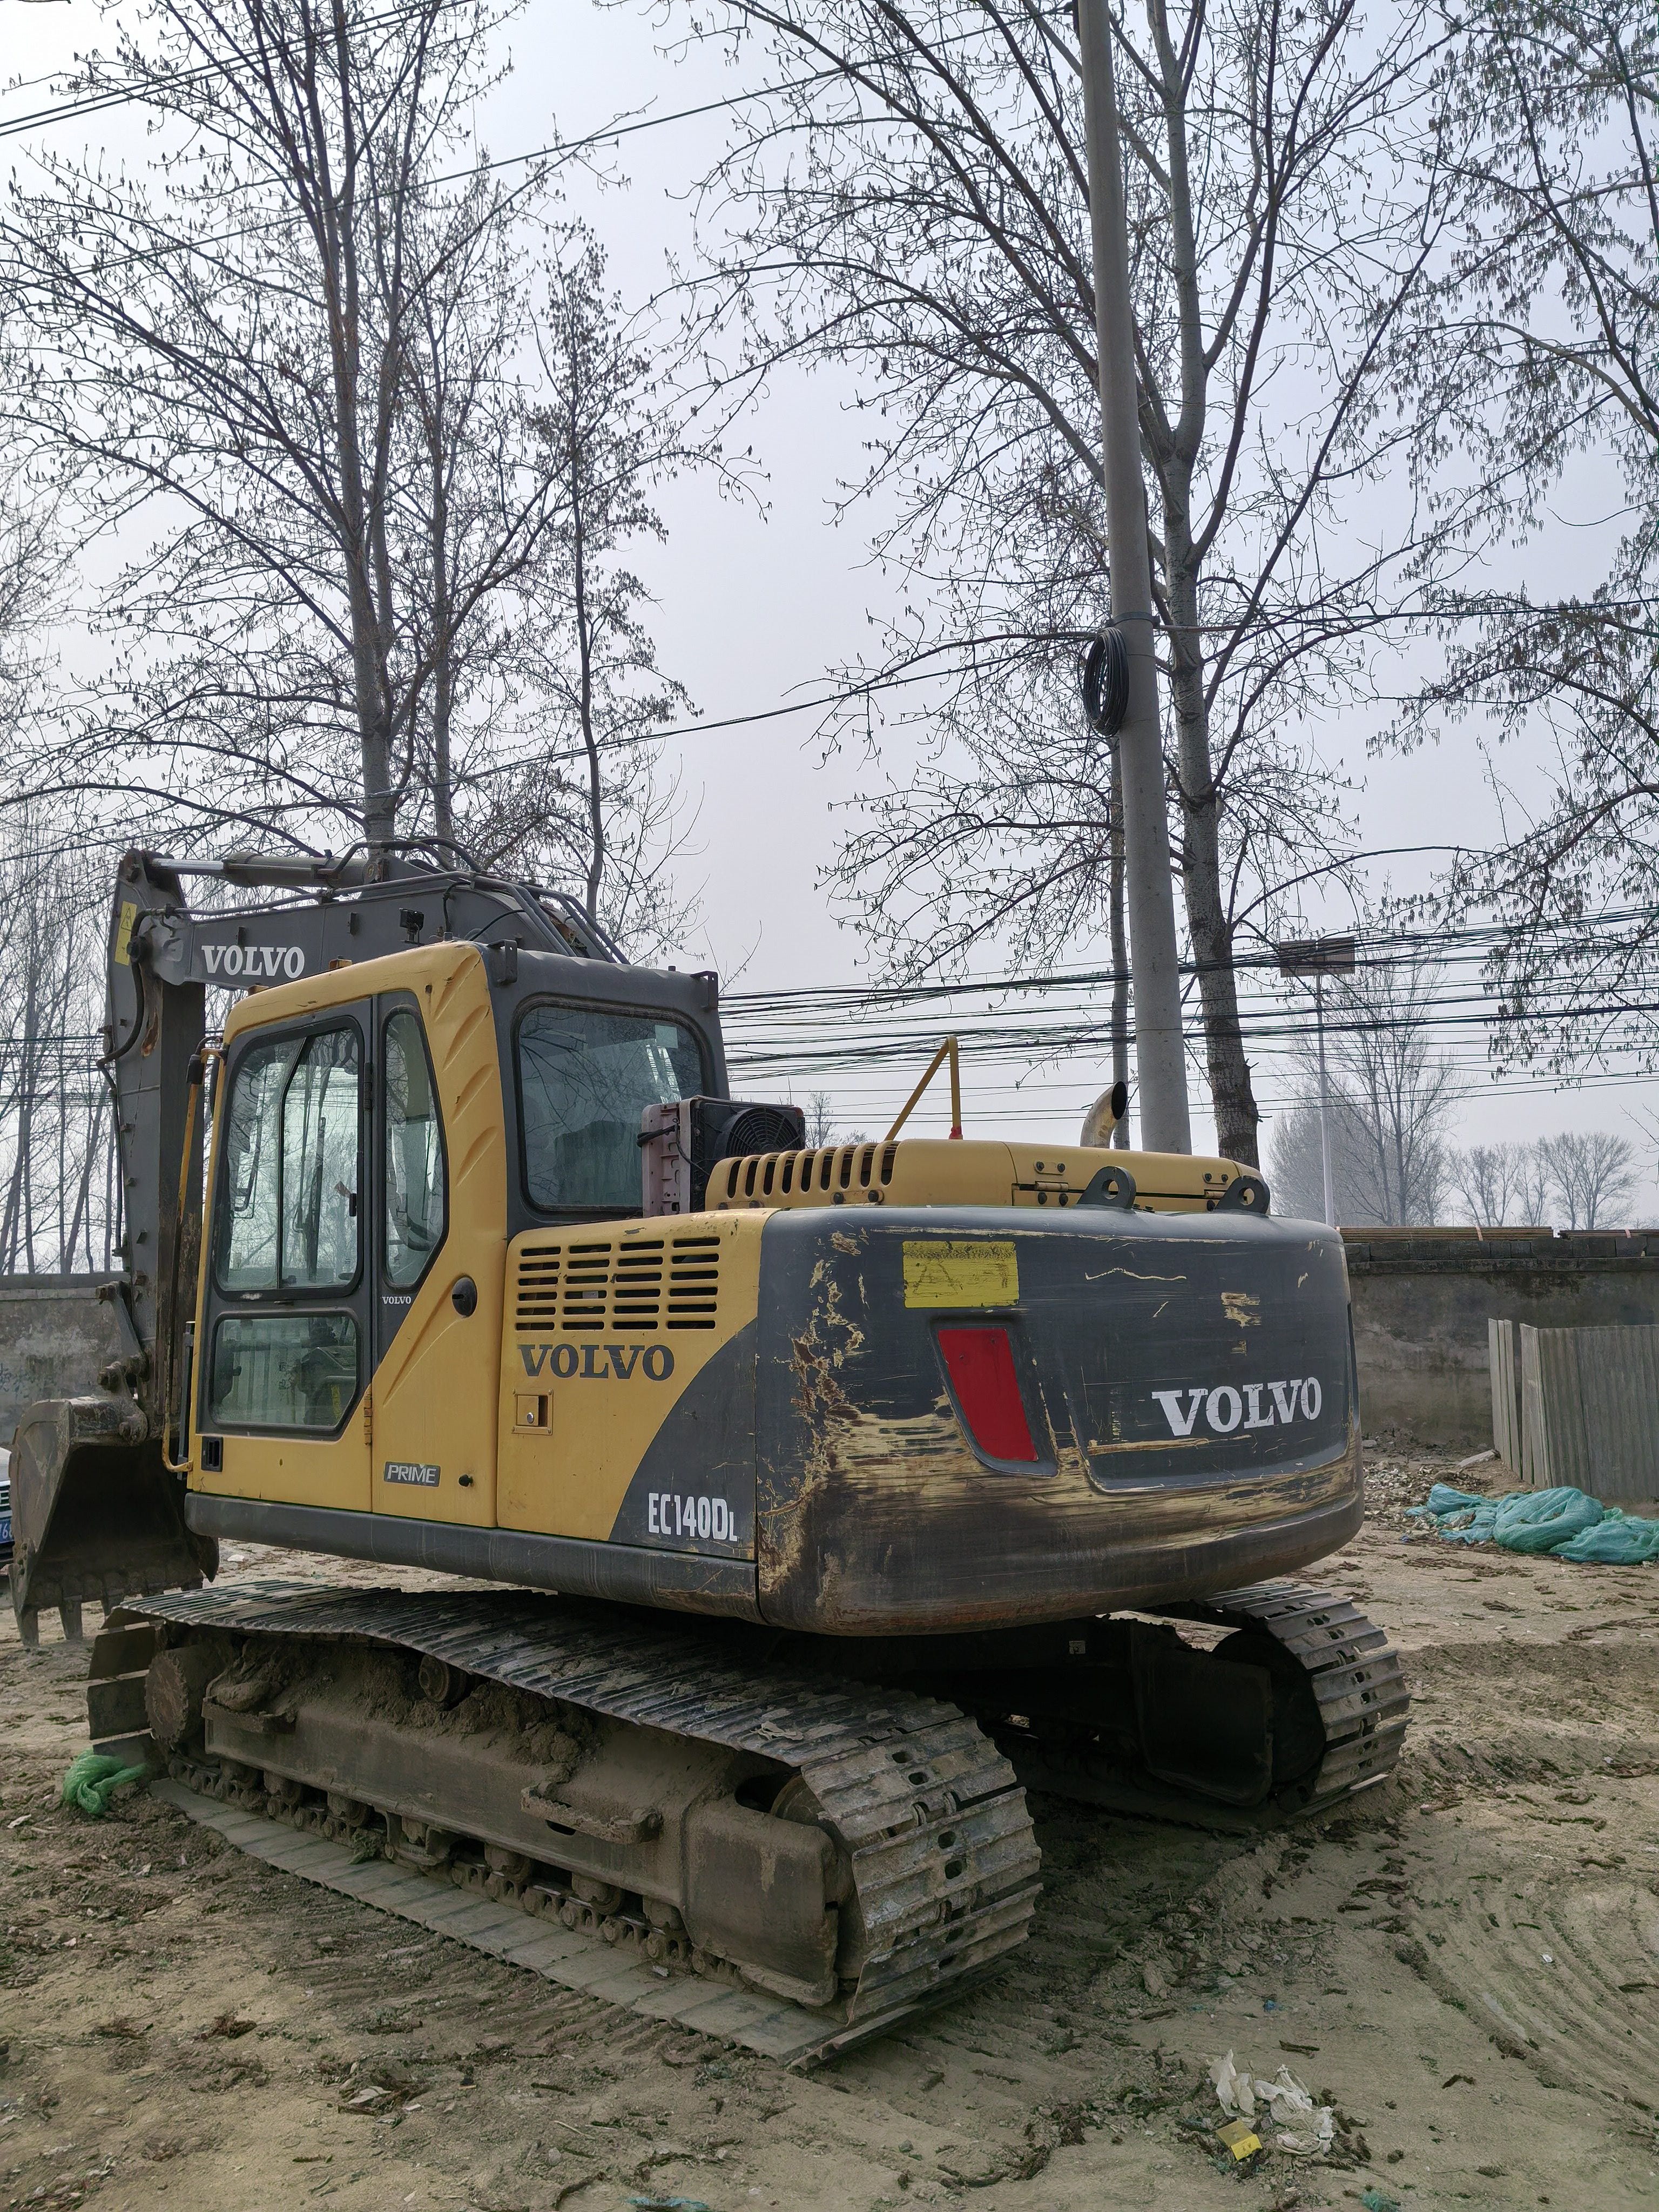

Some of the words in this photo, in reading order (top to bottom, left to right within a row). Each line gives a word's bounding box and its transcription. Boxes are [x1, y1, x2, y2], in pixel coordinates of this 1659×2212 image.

[201, 945, 305, 979] VOLVO
[381, 1296, 412, 1304] VOLVO
[517, 1343, 675, 1381] VOLVO
[1151, 1377, 1322, 1436] VOLVO
[387, 1465, 437, 1483] PRIME
